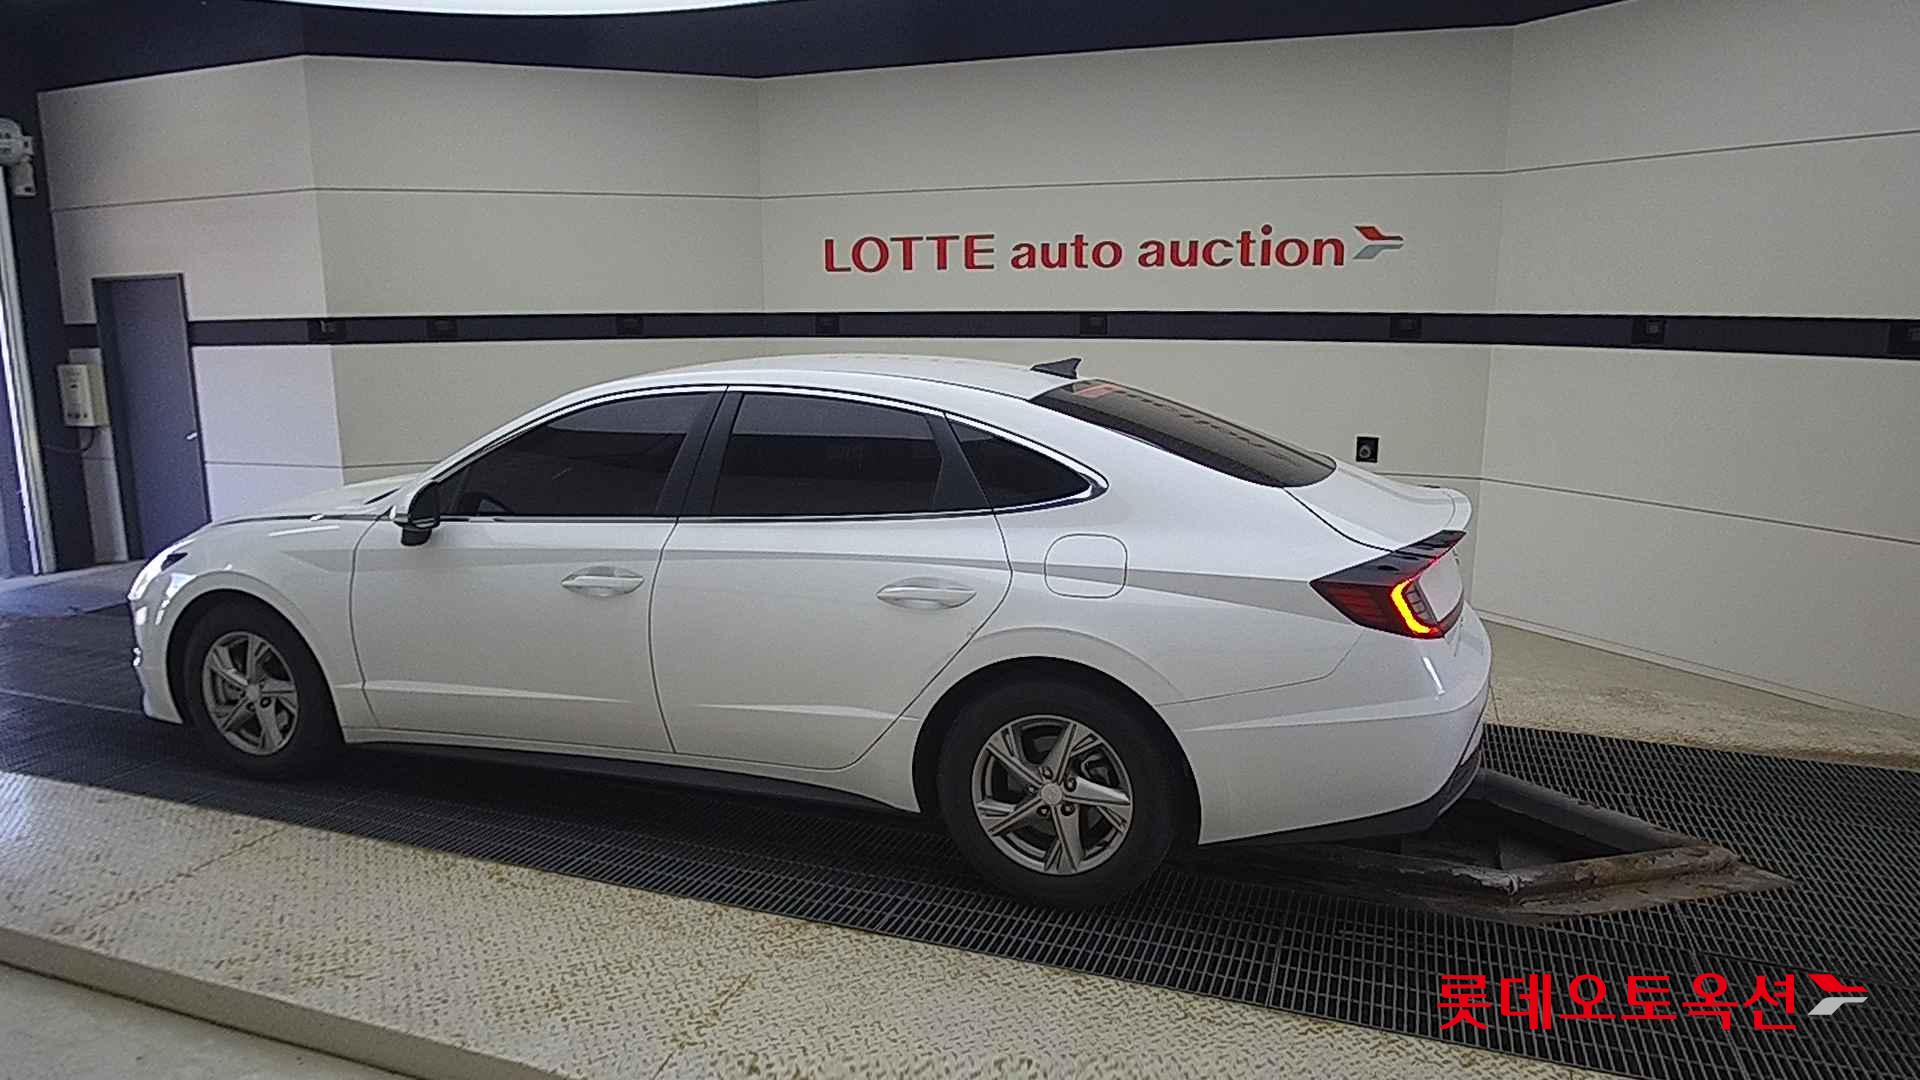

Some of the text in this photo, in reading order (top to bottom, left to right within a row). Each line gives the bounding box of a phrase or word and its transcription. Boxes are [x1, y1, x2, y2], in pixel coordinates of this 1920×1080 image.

[824, 224, 1345, 272] LOTTE auto auction
